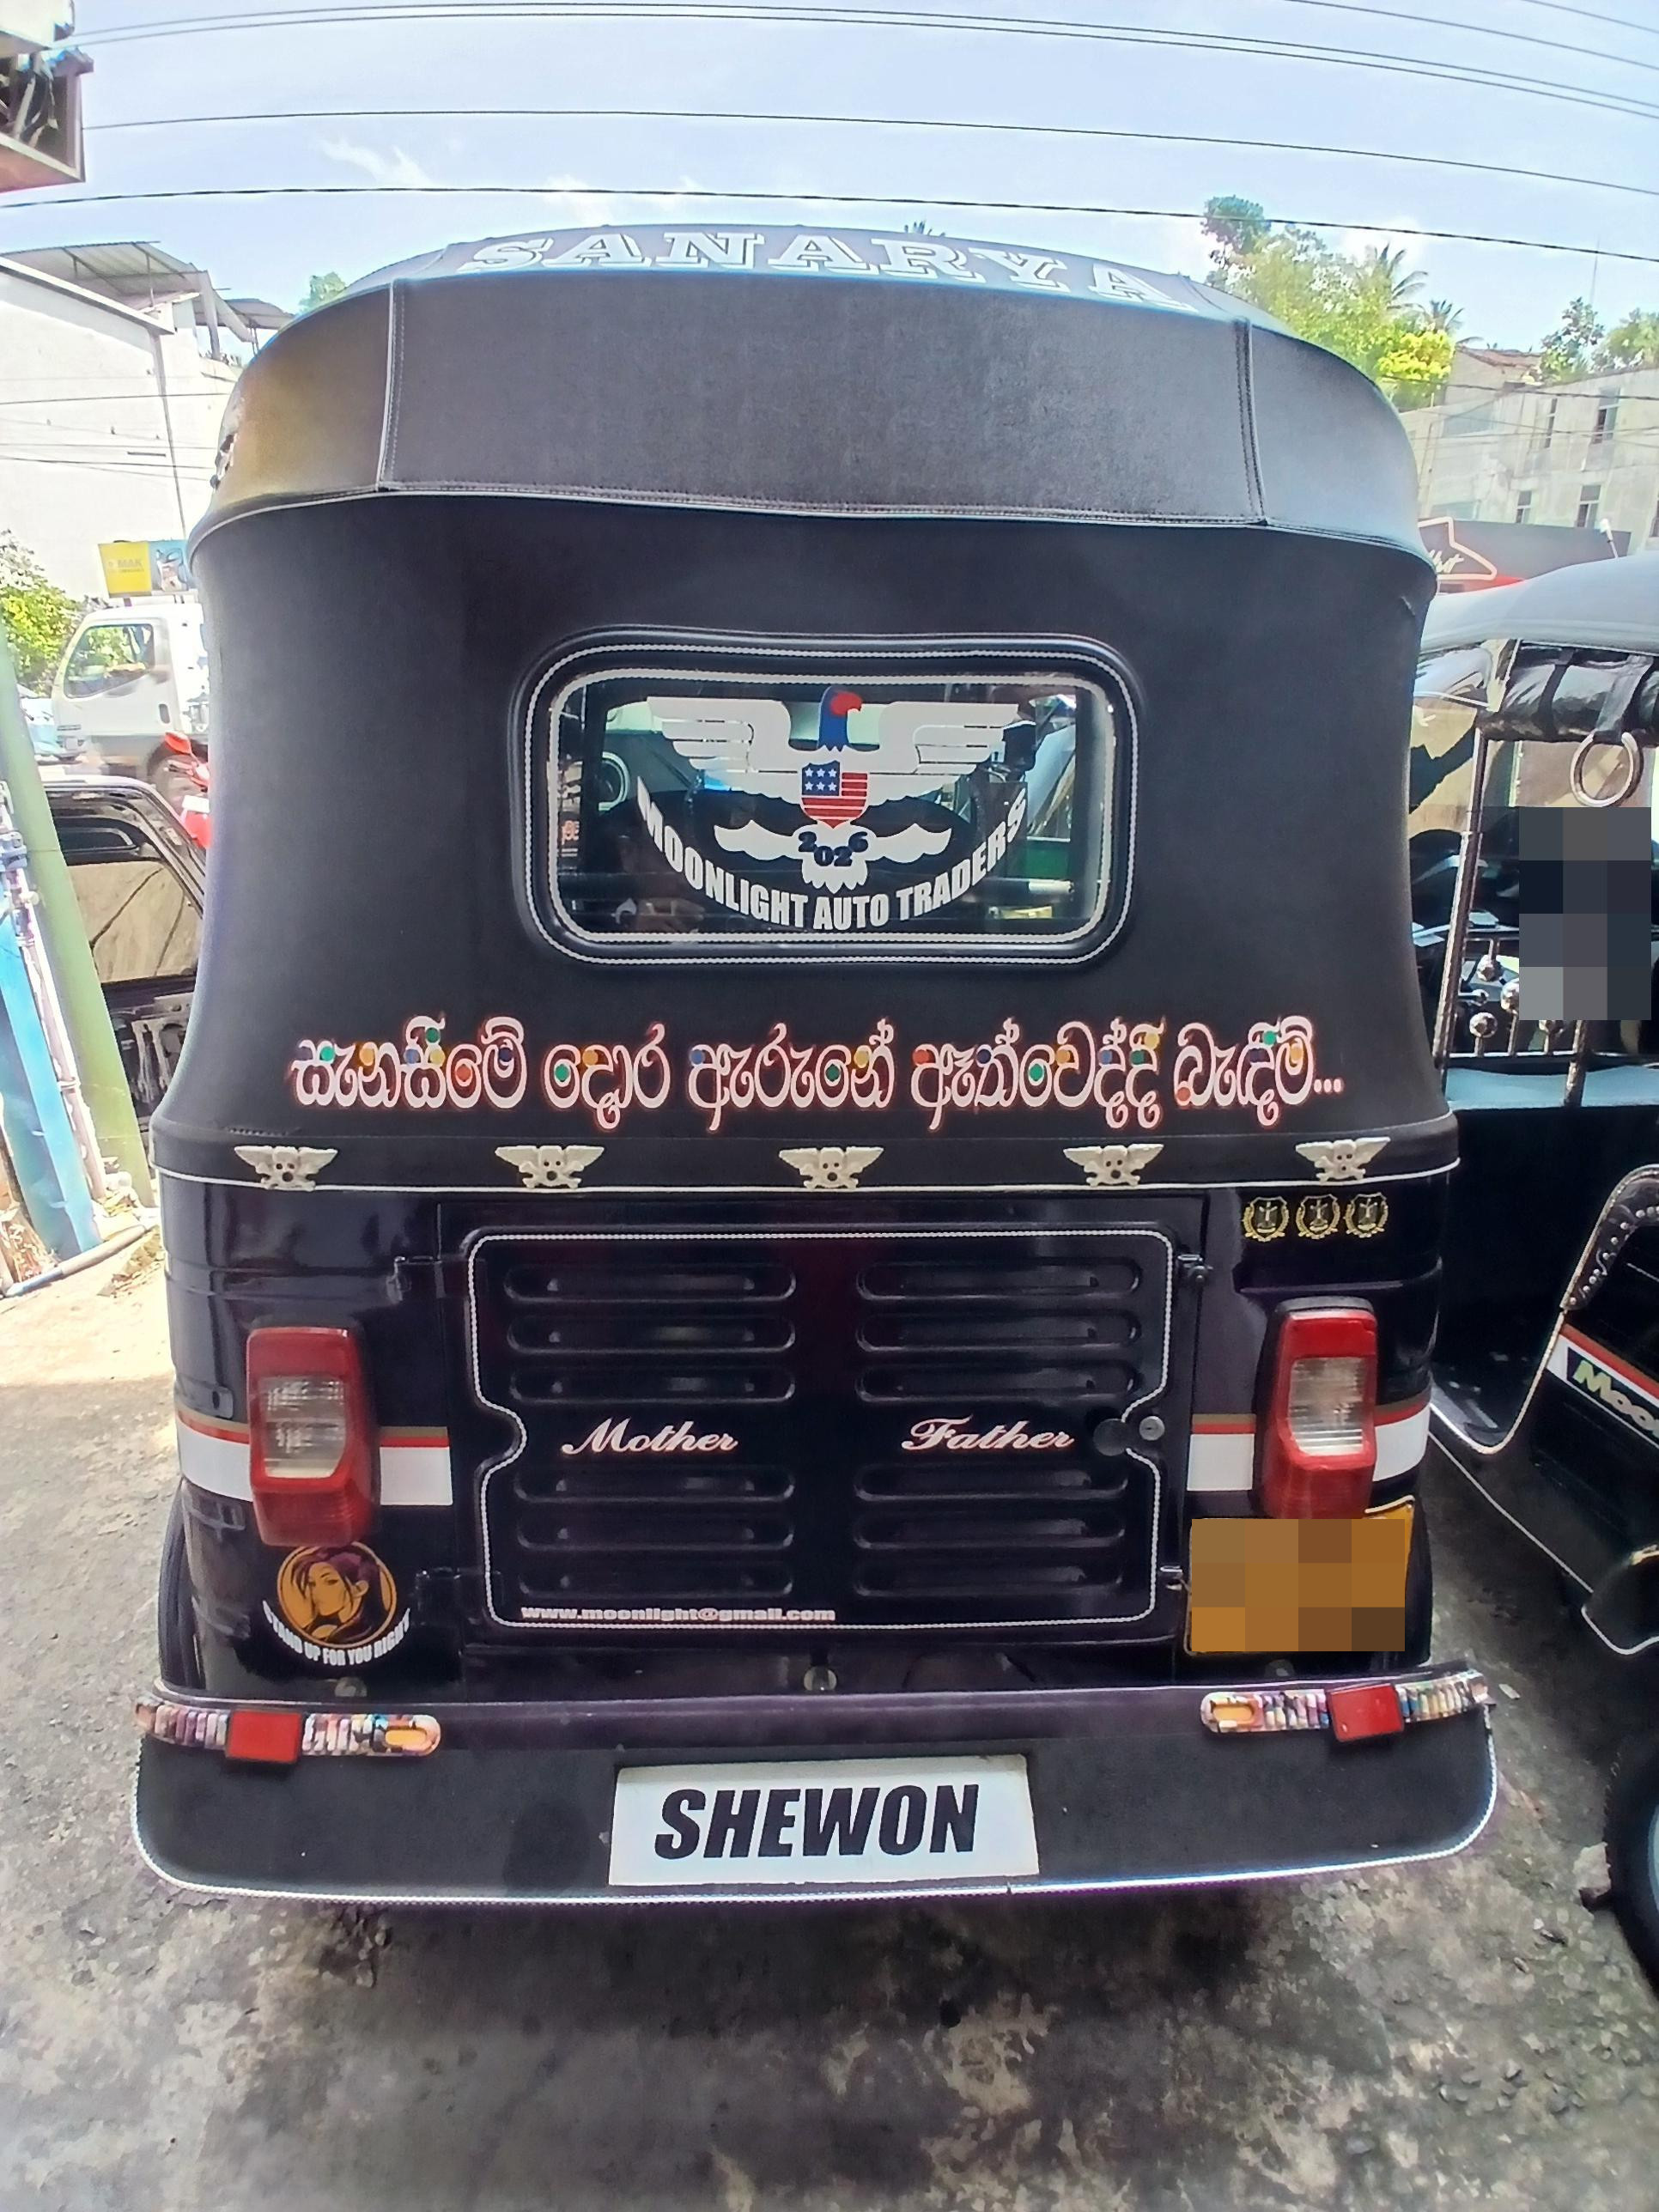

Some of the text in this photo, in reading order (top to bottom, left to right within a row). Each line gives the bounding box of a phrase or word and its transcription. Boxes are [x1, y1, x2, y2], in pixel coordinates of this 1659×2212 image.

[458, 231, 1200, 313] SANARYA
[635, 775, 1029, 931] MOONLIGHT AUTO TRADERS
[798, 830, 869, 867] 2026
[544, 1023, 671, 1129] දොර
[561, 1417, 738, 1455] Mother
[901, 1413, 1075, 1450] Father
[1572, 1359, 1659, 1439] Moo
[304, 1641, 321, 1662] UP
[322, 1647, 346, 1666] FOR
[347, 1644, 373, 1665] YOU
[374, 1607, 410, 1658] RIGHT
[654, 1784, 979, 1859] SHEWON
